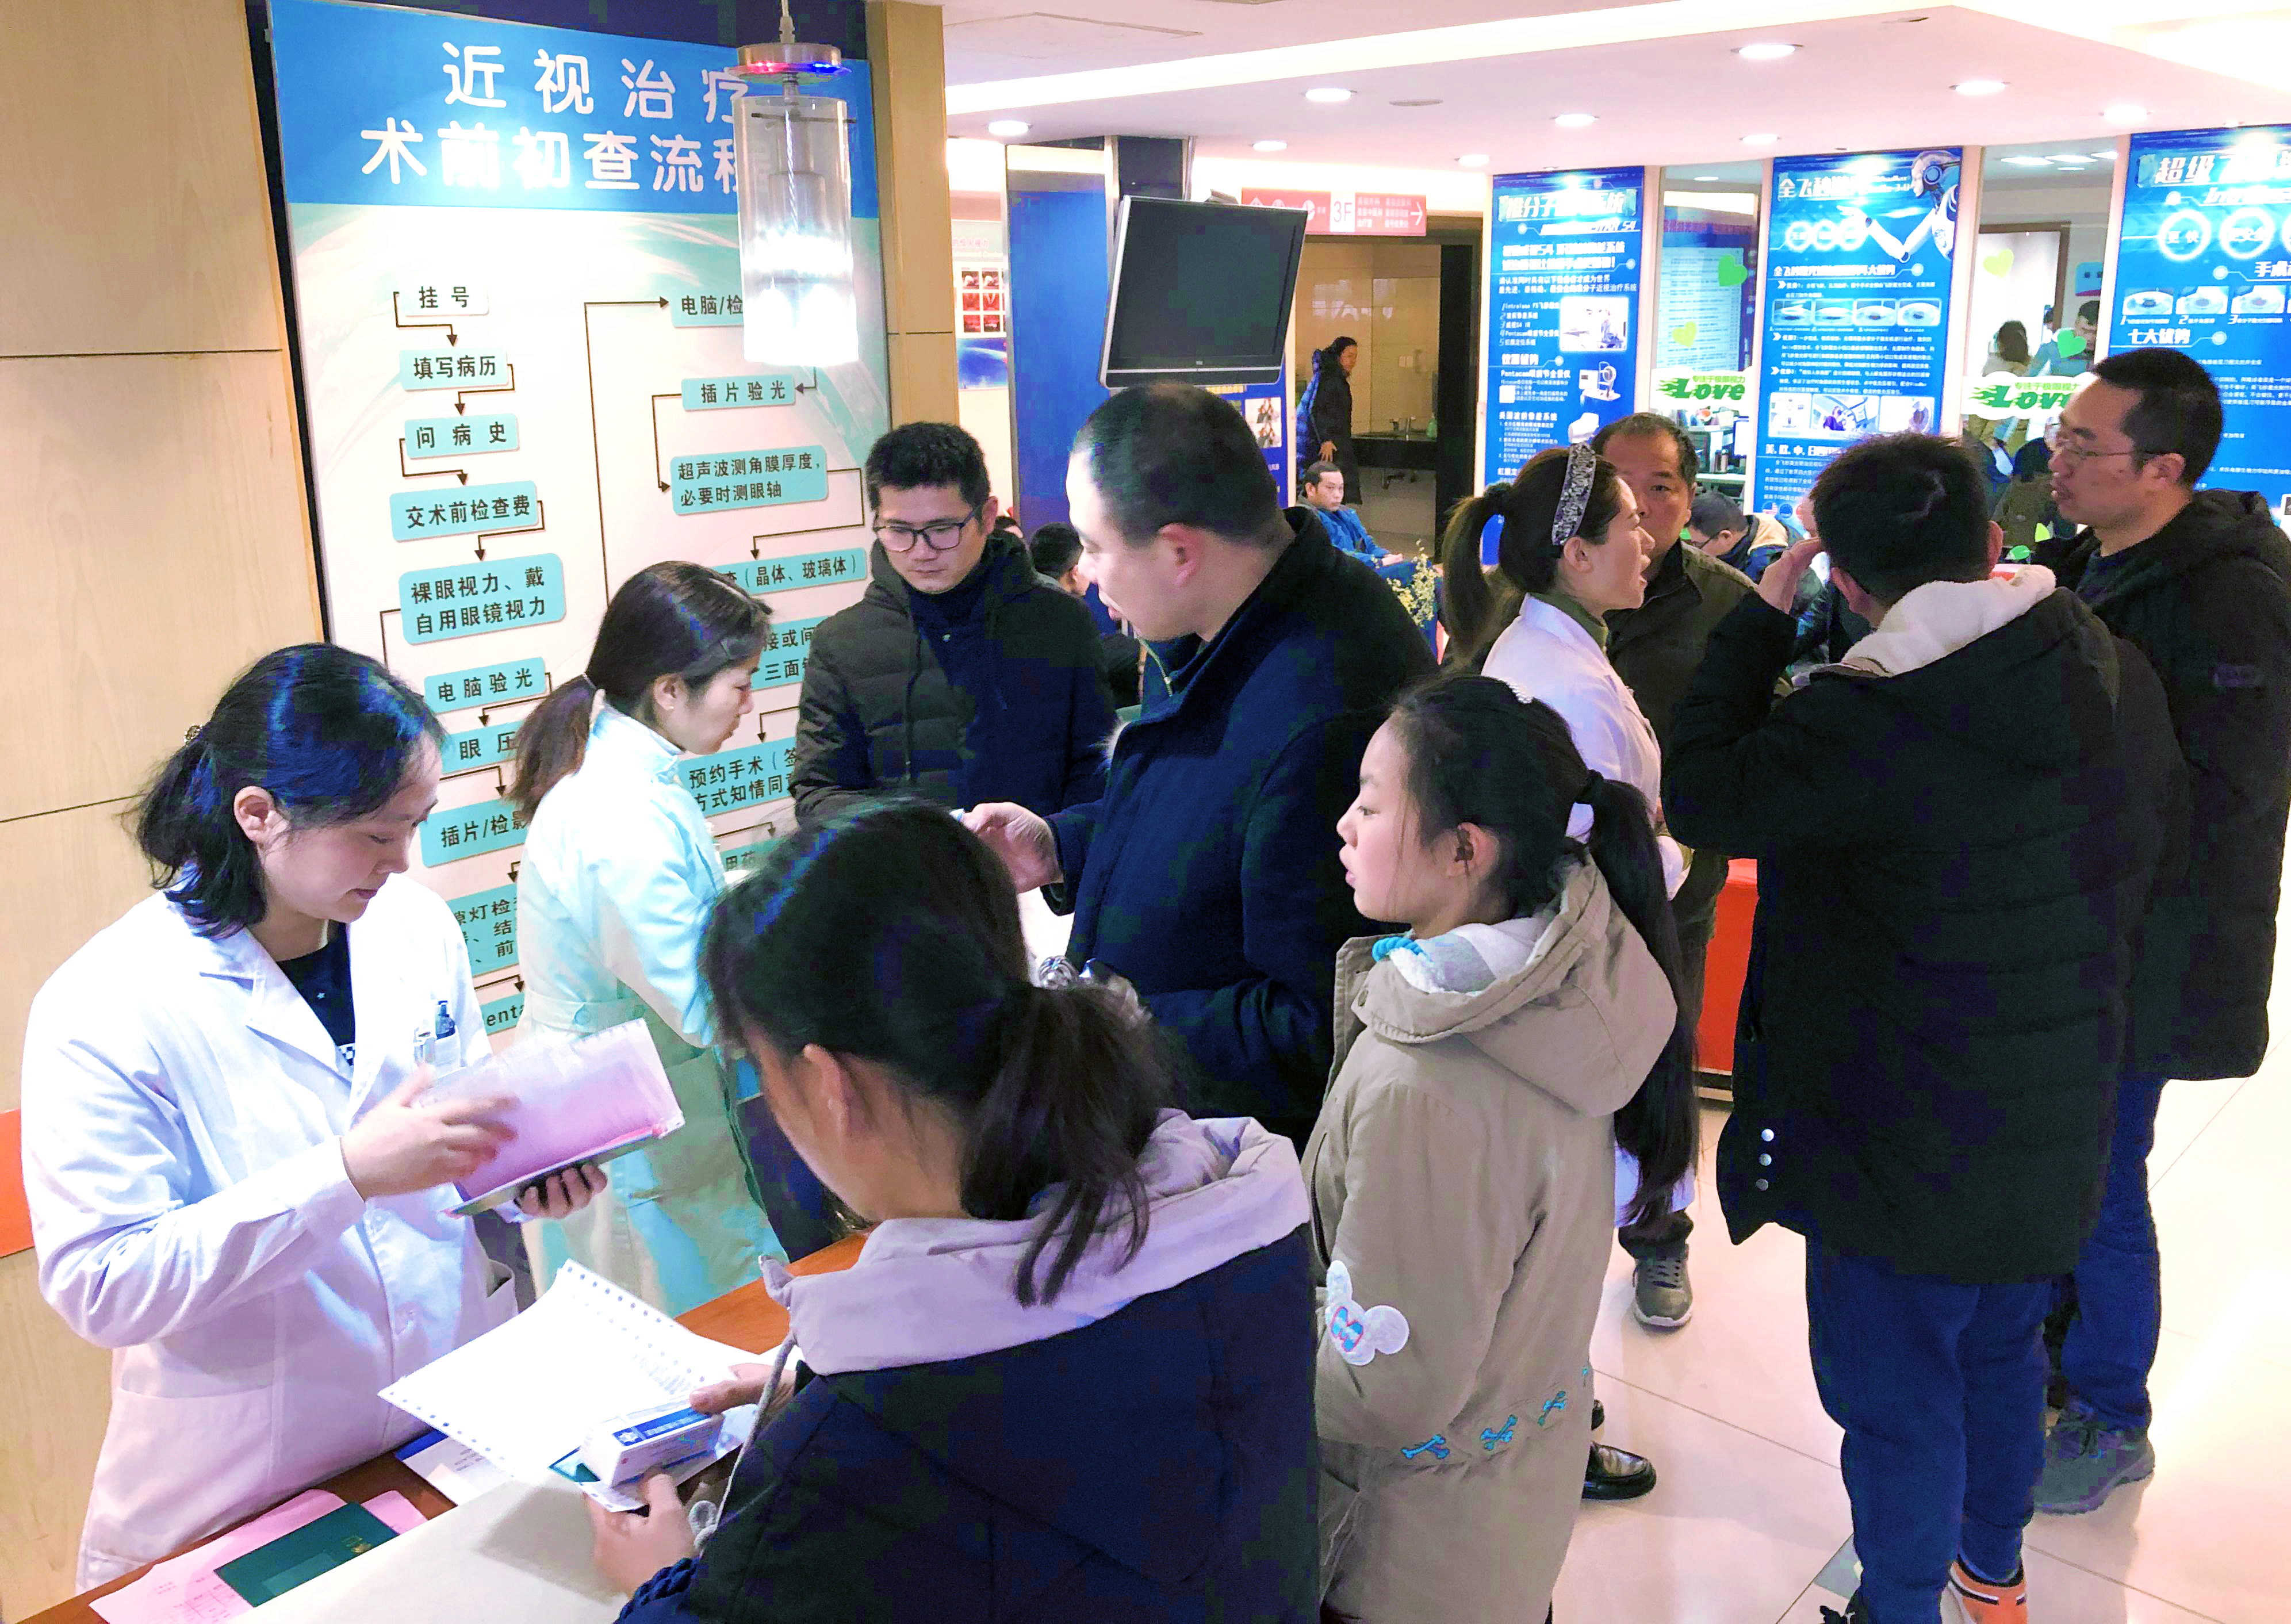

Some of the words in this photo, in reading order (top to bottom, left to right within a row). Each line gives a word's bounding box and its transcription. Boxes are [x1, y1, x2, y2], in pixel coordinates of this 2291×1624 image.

[442, 41, 749, 123] 近视治疗
[1333, 201, 1353, 223] 3F
[2254, 261, 2291, 277] 手术
[419, 286, 469, 308] 挂号
[681, 294, 743, 316] 电脑/检
[2128, 328, 2190, 344] 七大优势
[413, 354, 496, 380] 填写病历
[700, 380, 786, 404] 插片验光
[1664, 378, 1745, 400] Love
[416, 421, 507, 449] 问病史
[680, 481, 782, 507] 必要时测眼轴
[405, 495, 530, 529] 交术前检查费
[416, 596, 545, 635] 自用眼镜视力
[765, 657, 809, 681] 三面
[438, 668, 533, 703] 电脑验光
[459, 731, 518, 760] 眼压
[694, 773, 793, 812] 方式知情同
